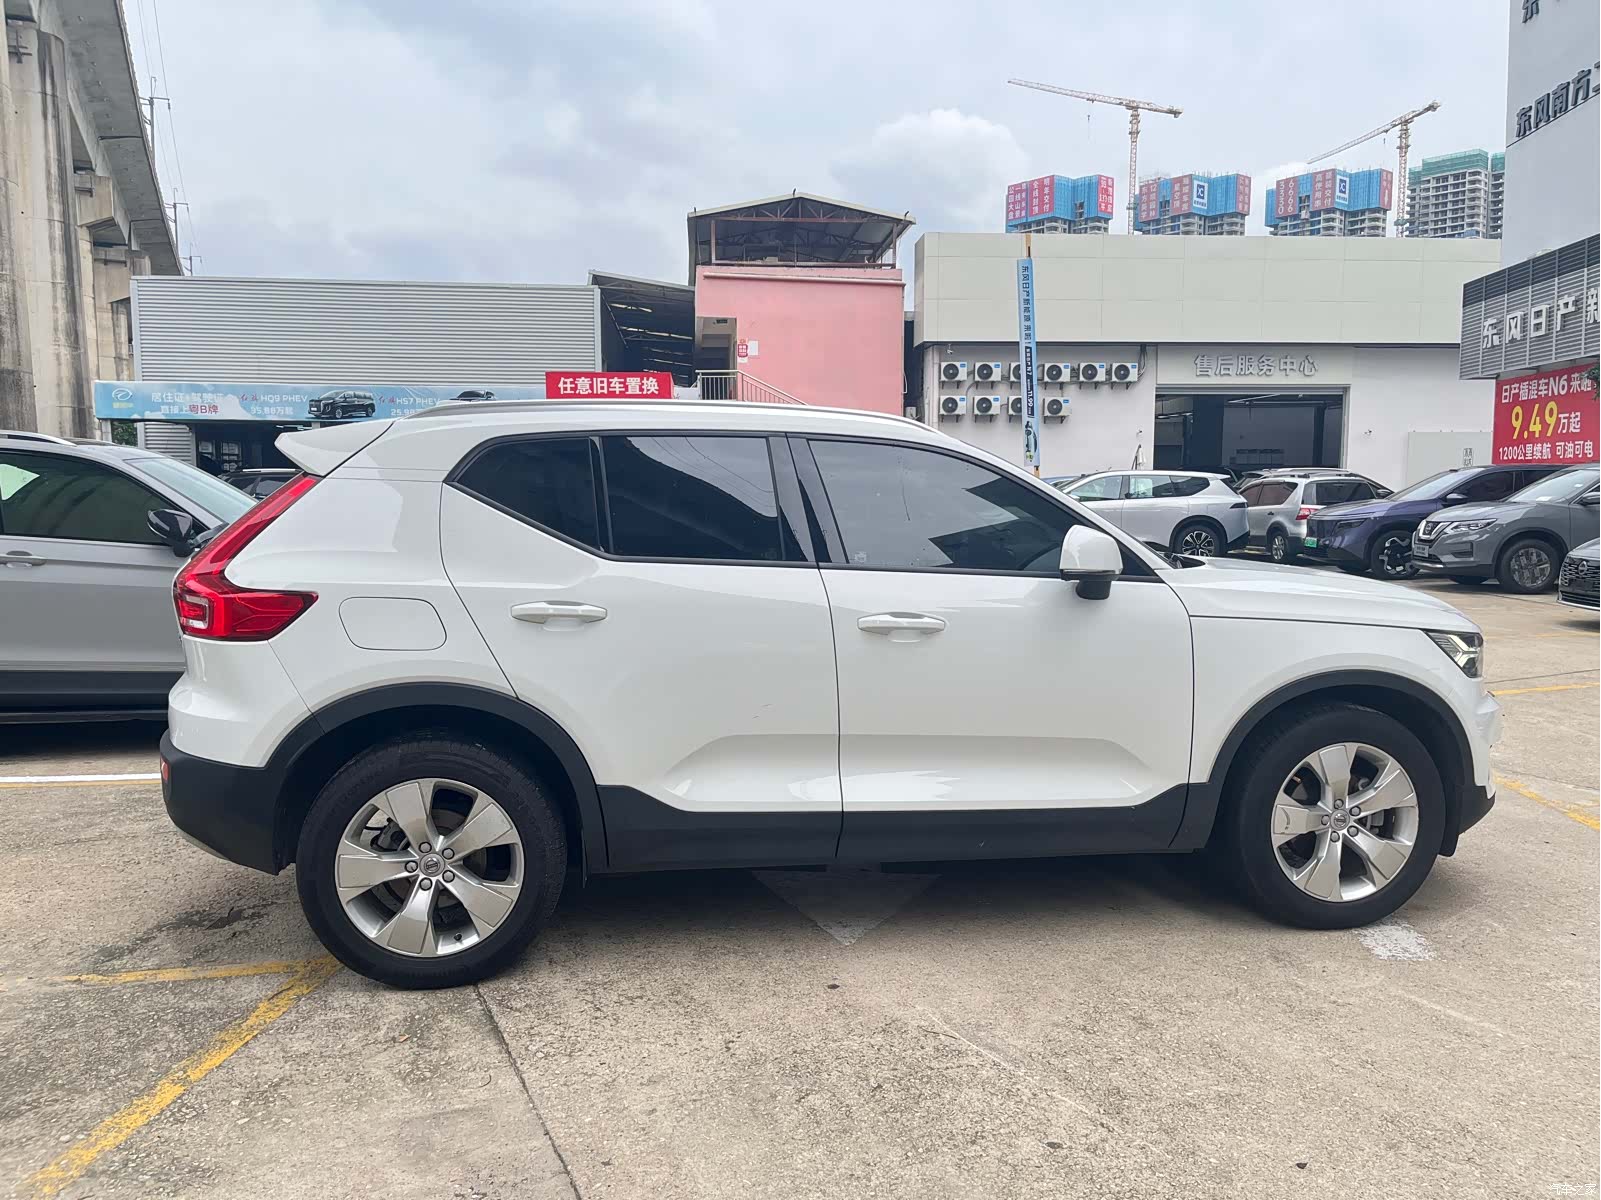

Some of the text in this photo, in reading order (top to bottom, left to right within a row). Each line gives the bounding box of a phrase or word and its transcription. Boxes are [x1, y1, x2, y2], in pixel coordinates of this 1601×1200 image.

[1021, 265, 1031, 323] 东风日产新能源
[1194, 354, 1318, 377] 售后服务中心
[557, 376, 660, 396] 任意旧车置换
[1501, 374, 1568, 404] 日产插混车N6
[260, 394, 281, 403] HQ9
[282, 394, 308, 403] PHEV
[1498, 440, 1594, 460] 1200公里续航 可油可电
